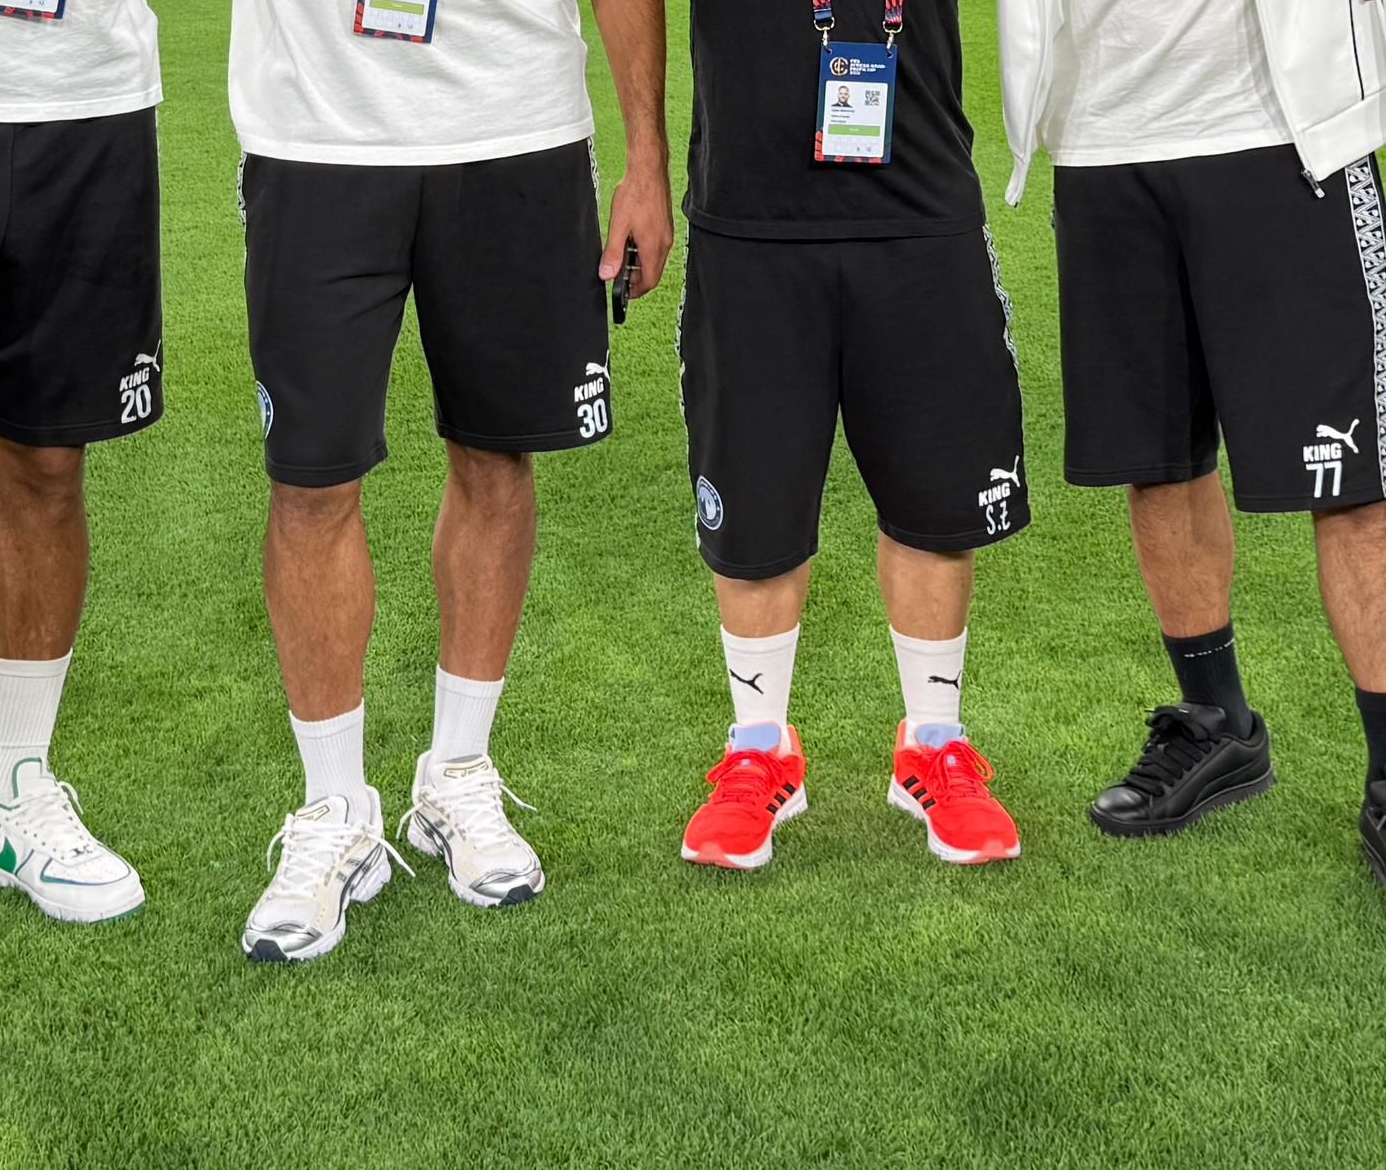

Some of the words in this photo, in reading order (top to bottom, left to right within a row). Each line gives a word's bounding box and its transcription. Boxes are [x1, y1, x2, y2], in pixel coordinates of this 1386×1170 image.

[119, 367, 150, 394] KING
[573, 376, 605, 404] KING
[120, 384, 152, 424] 20
[577, 398, 609, 440] 30
[1303, 442, 1343, 463] KING
[979, 482, 1011, 508] KING
[1305, 461, 1343, 499] 77
[985, 500, 1011, 536] S.Z
